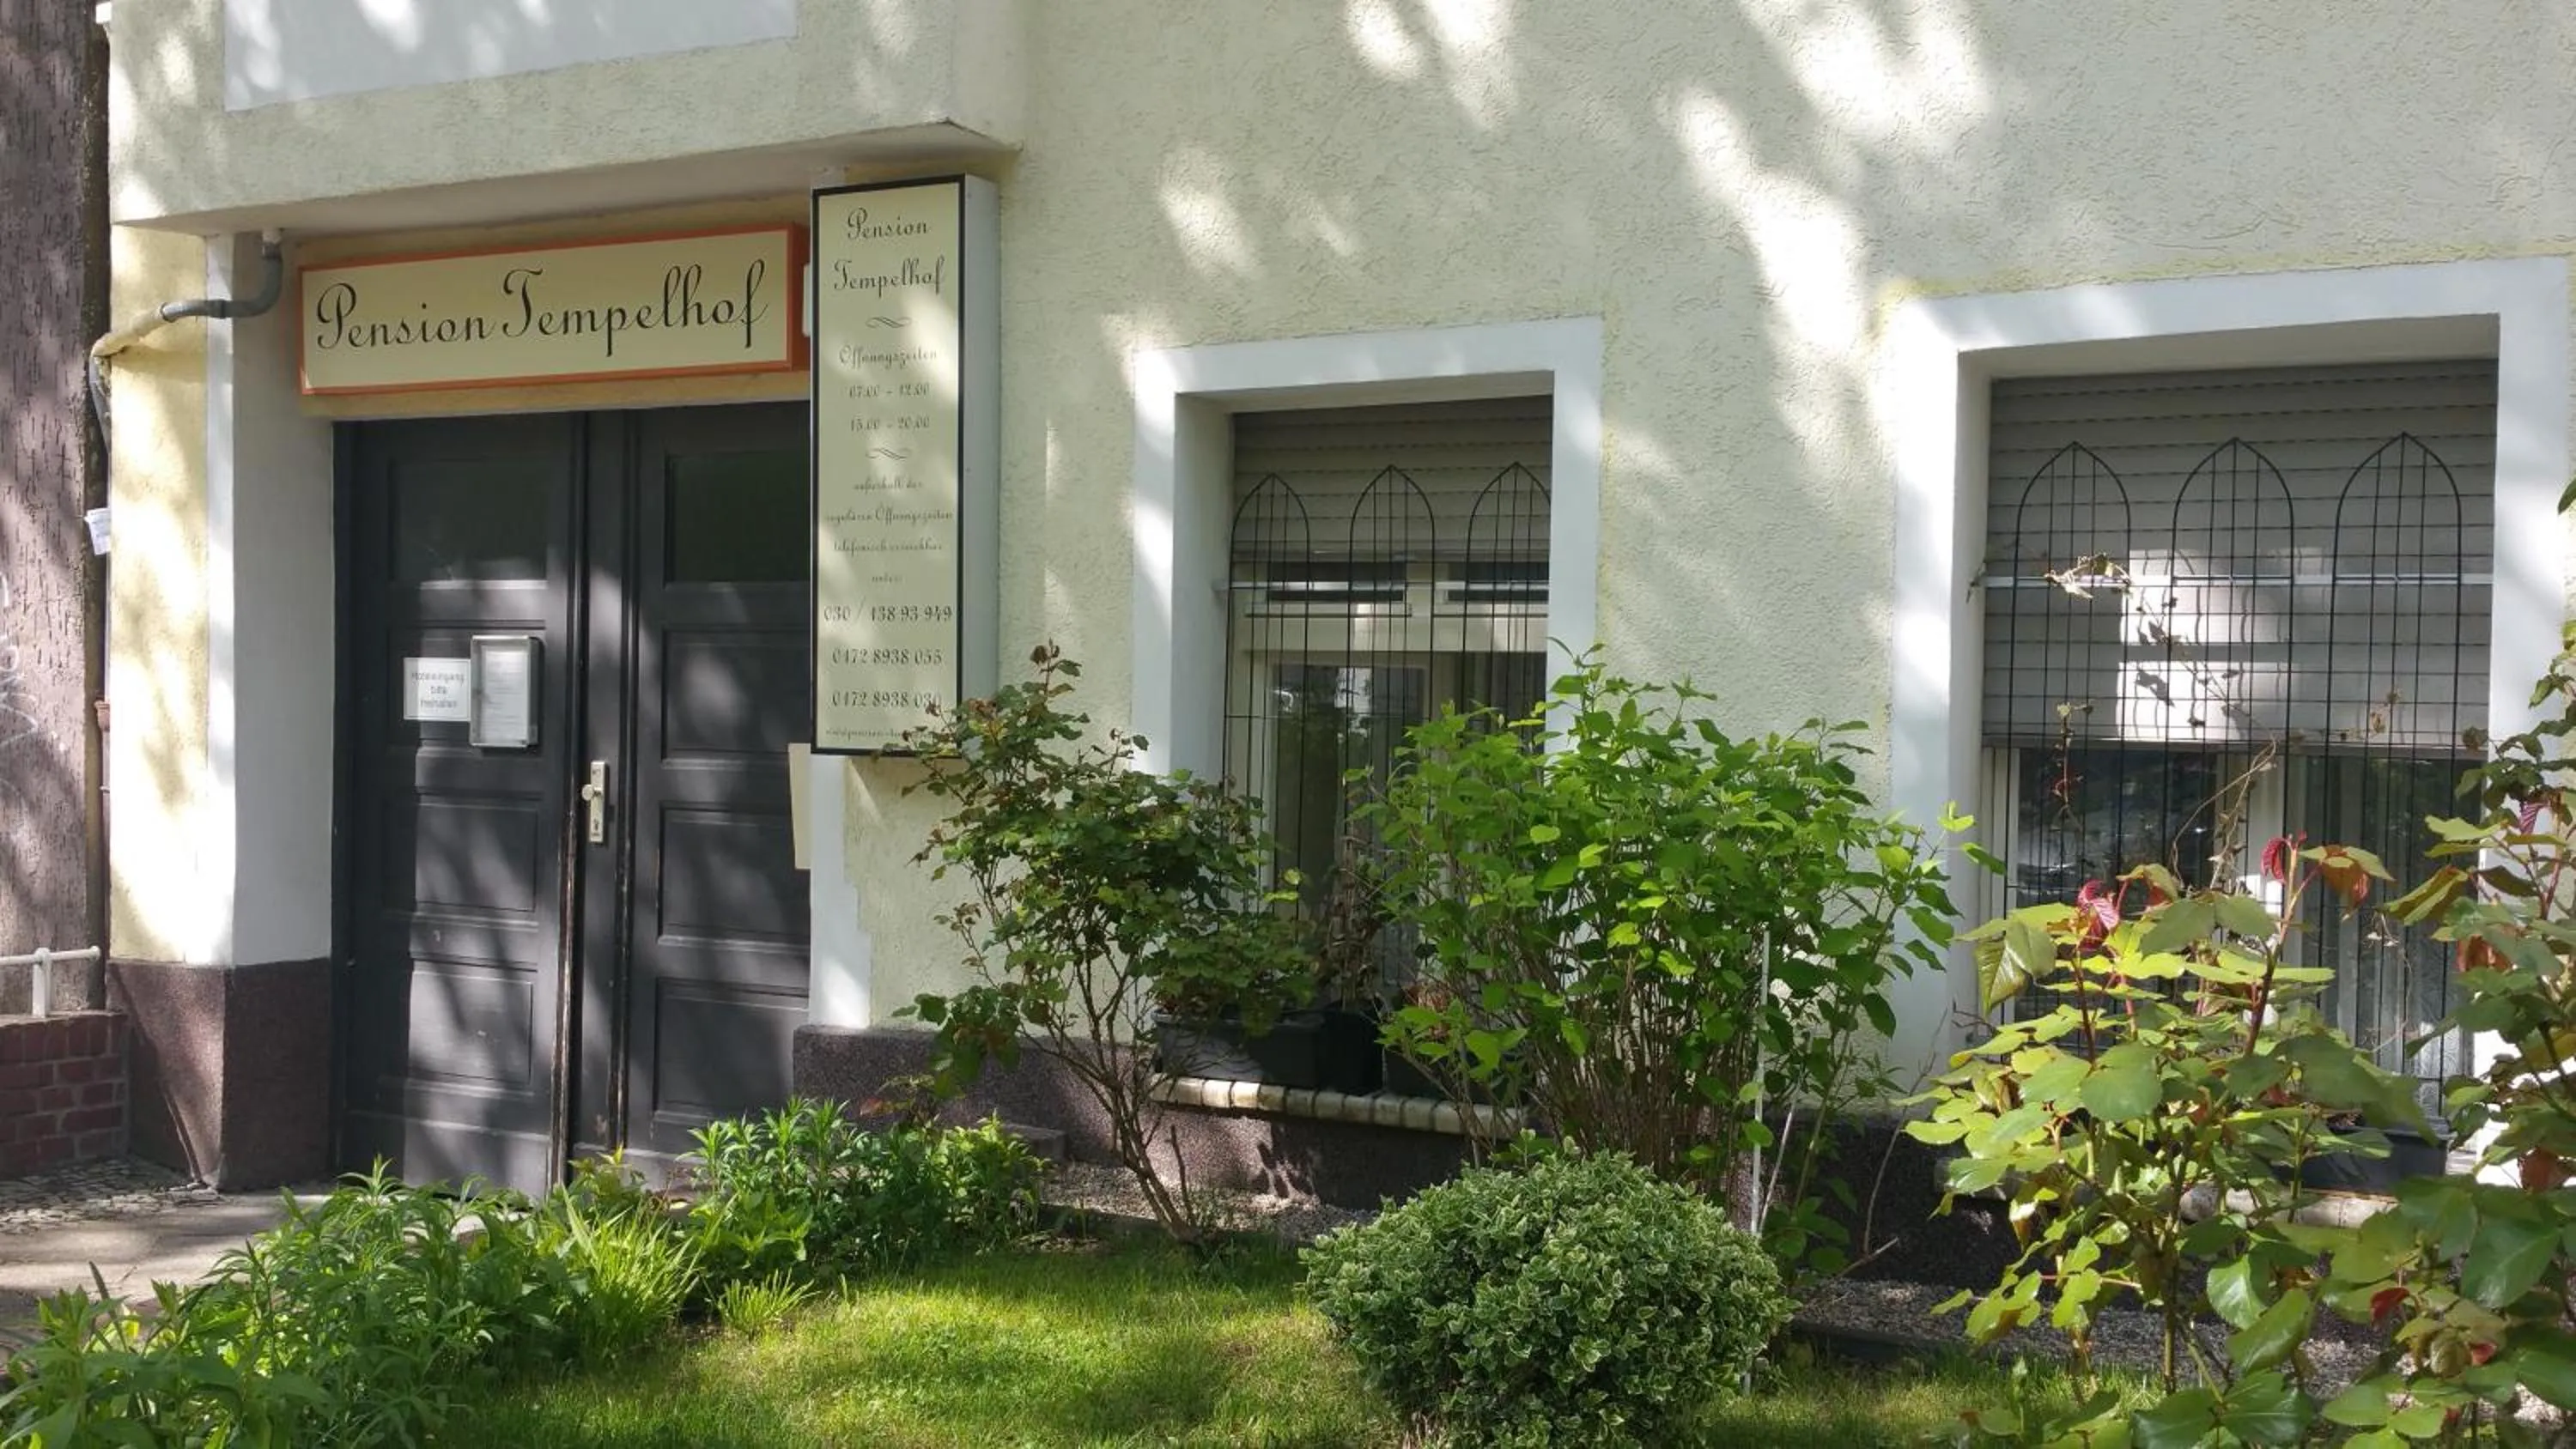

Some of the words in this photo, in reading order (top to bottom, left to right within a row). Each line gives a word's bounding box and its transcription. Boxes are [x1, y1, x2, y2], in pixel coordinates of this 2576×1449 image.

[848, 207, 928, 239] Pension
[833, 255, 945, 298] Tempelhof
[316, 282, 496, 349] Pension
[502, 258, 769, 356] Tempelhof
[824, 604, 851, 622] 030
[871, 604, 896, 622] 138
[900, 604, 919, 621] 93
[872, 648, 910, 666] 8938
[914, 648, 943, 666] 055
[872, 690, 909, 708] 8938
